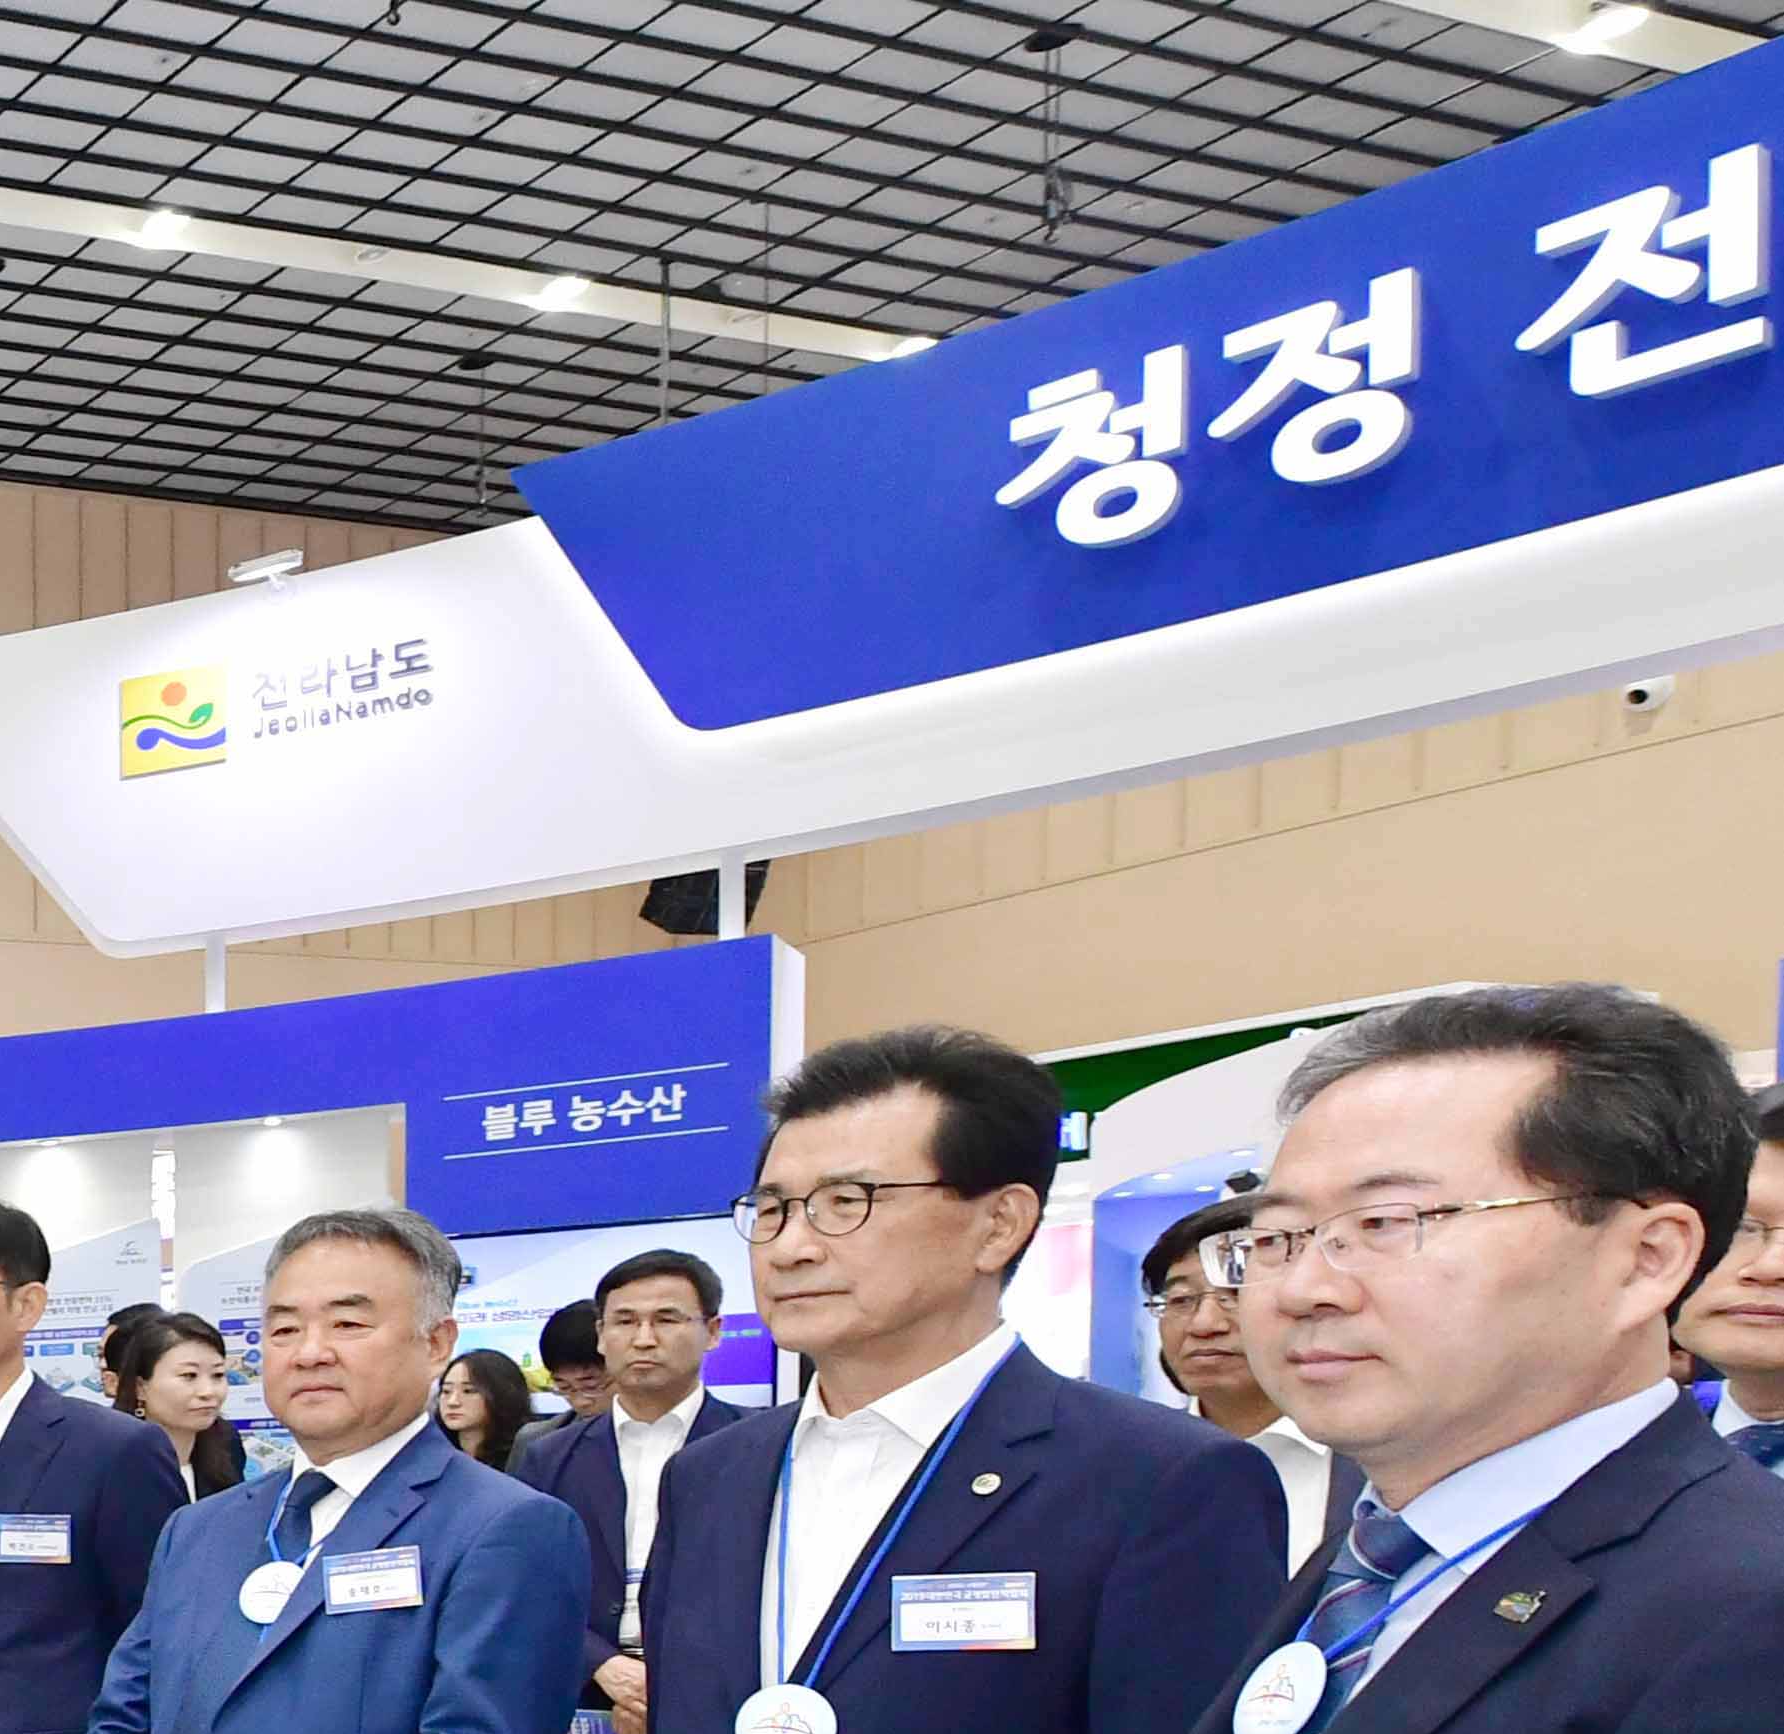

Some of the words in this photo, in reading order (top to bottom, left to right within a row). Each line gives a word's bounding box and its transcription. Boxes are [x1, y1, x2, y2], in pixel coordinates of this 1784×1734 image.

[995, 266, 1423, 550] 청정
[1515, 142, 1776, 398] 전
[252, 638, 434, 711] 전라남도
[481, 1103, 557, 1142] 블루
[567, 1083, 688, 1132] 농수산
